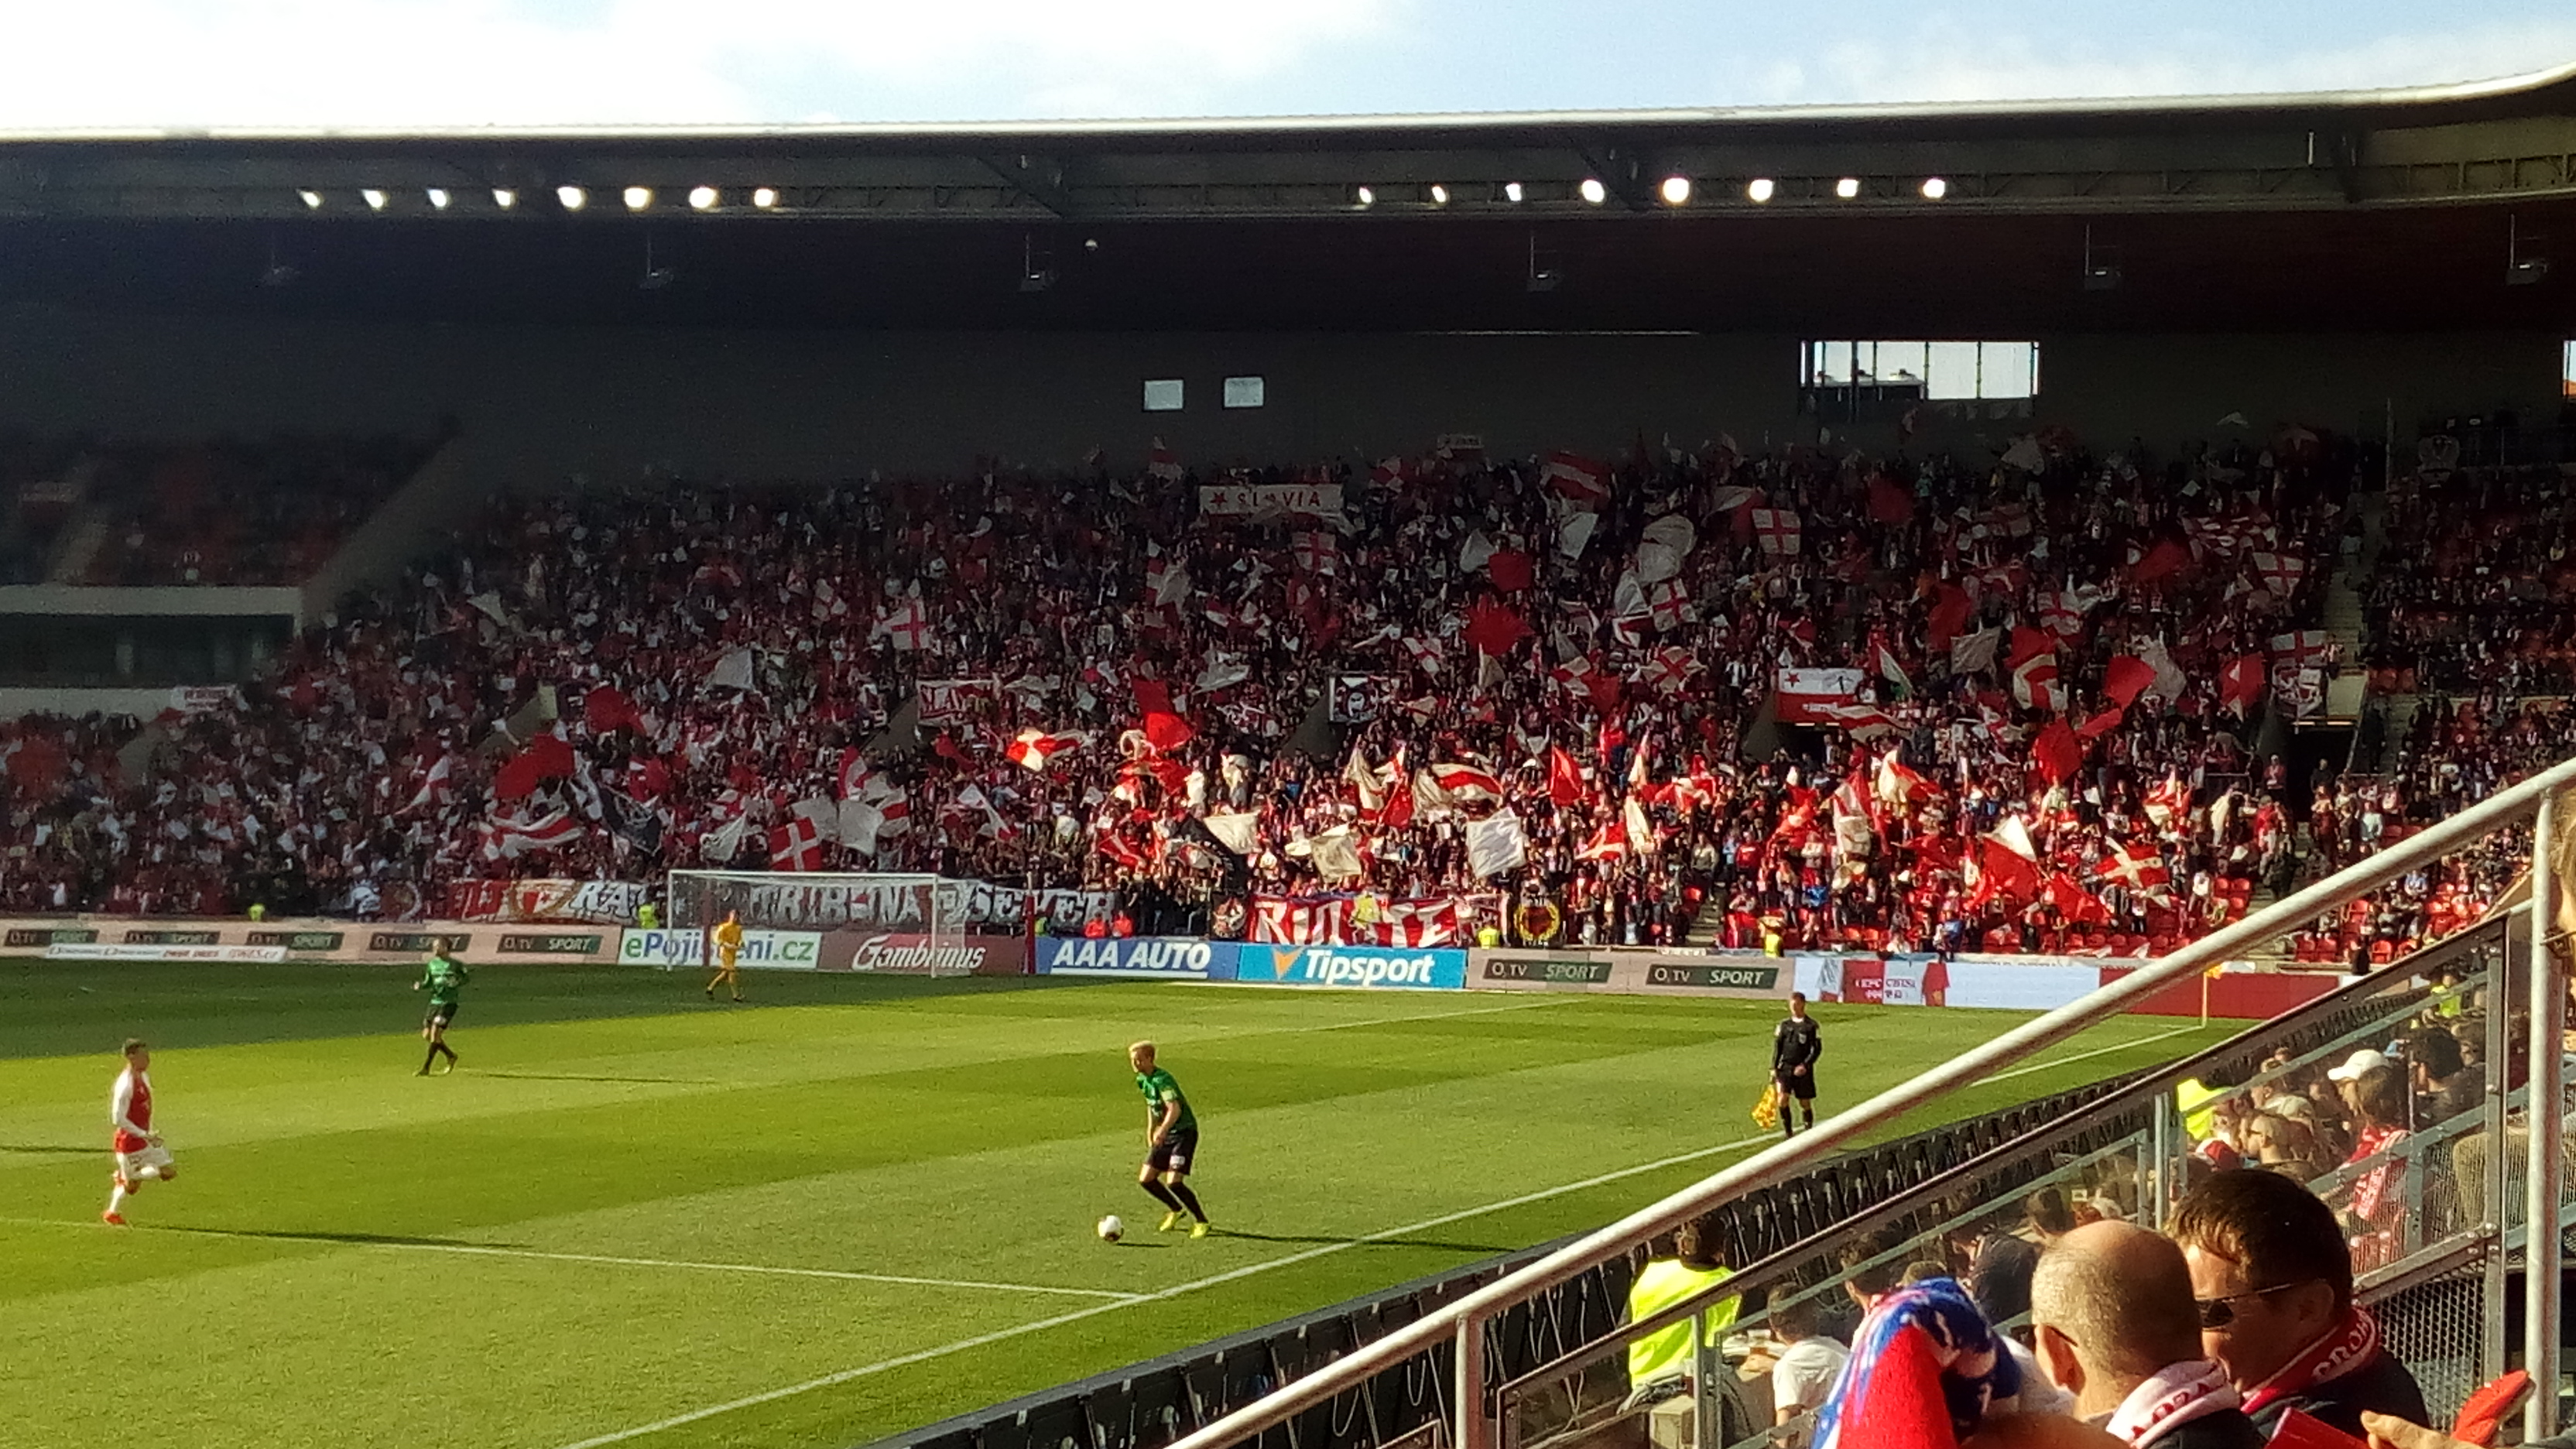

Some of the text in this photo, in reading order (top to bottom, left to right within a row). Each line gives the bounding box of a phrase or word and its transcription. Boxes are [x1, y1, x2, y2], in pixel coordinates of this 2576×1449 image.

[549, 937, 591, 951] SPORT
[625, 930, 814, 964] ePojini.cz
[1052, 940, 1212, 970] AAA AUTO
[1305, 949, 1435, 986] Tipsport
[1510, 964, 1527, 977] TV
[1545, 964, 1600, 980] SPORT
[1673, 970, 1690, 982] TV
[1710, 970, 1764, 985] SPORT
